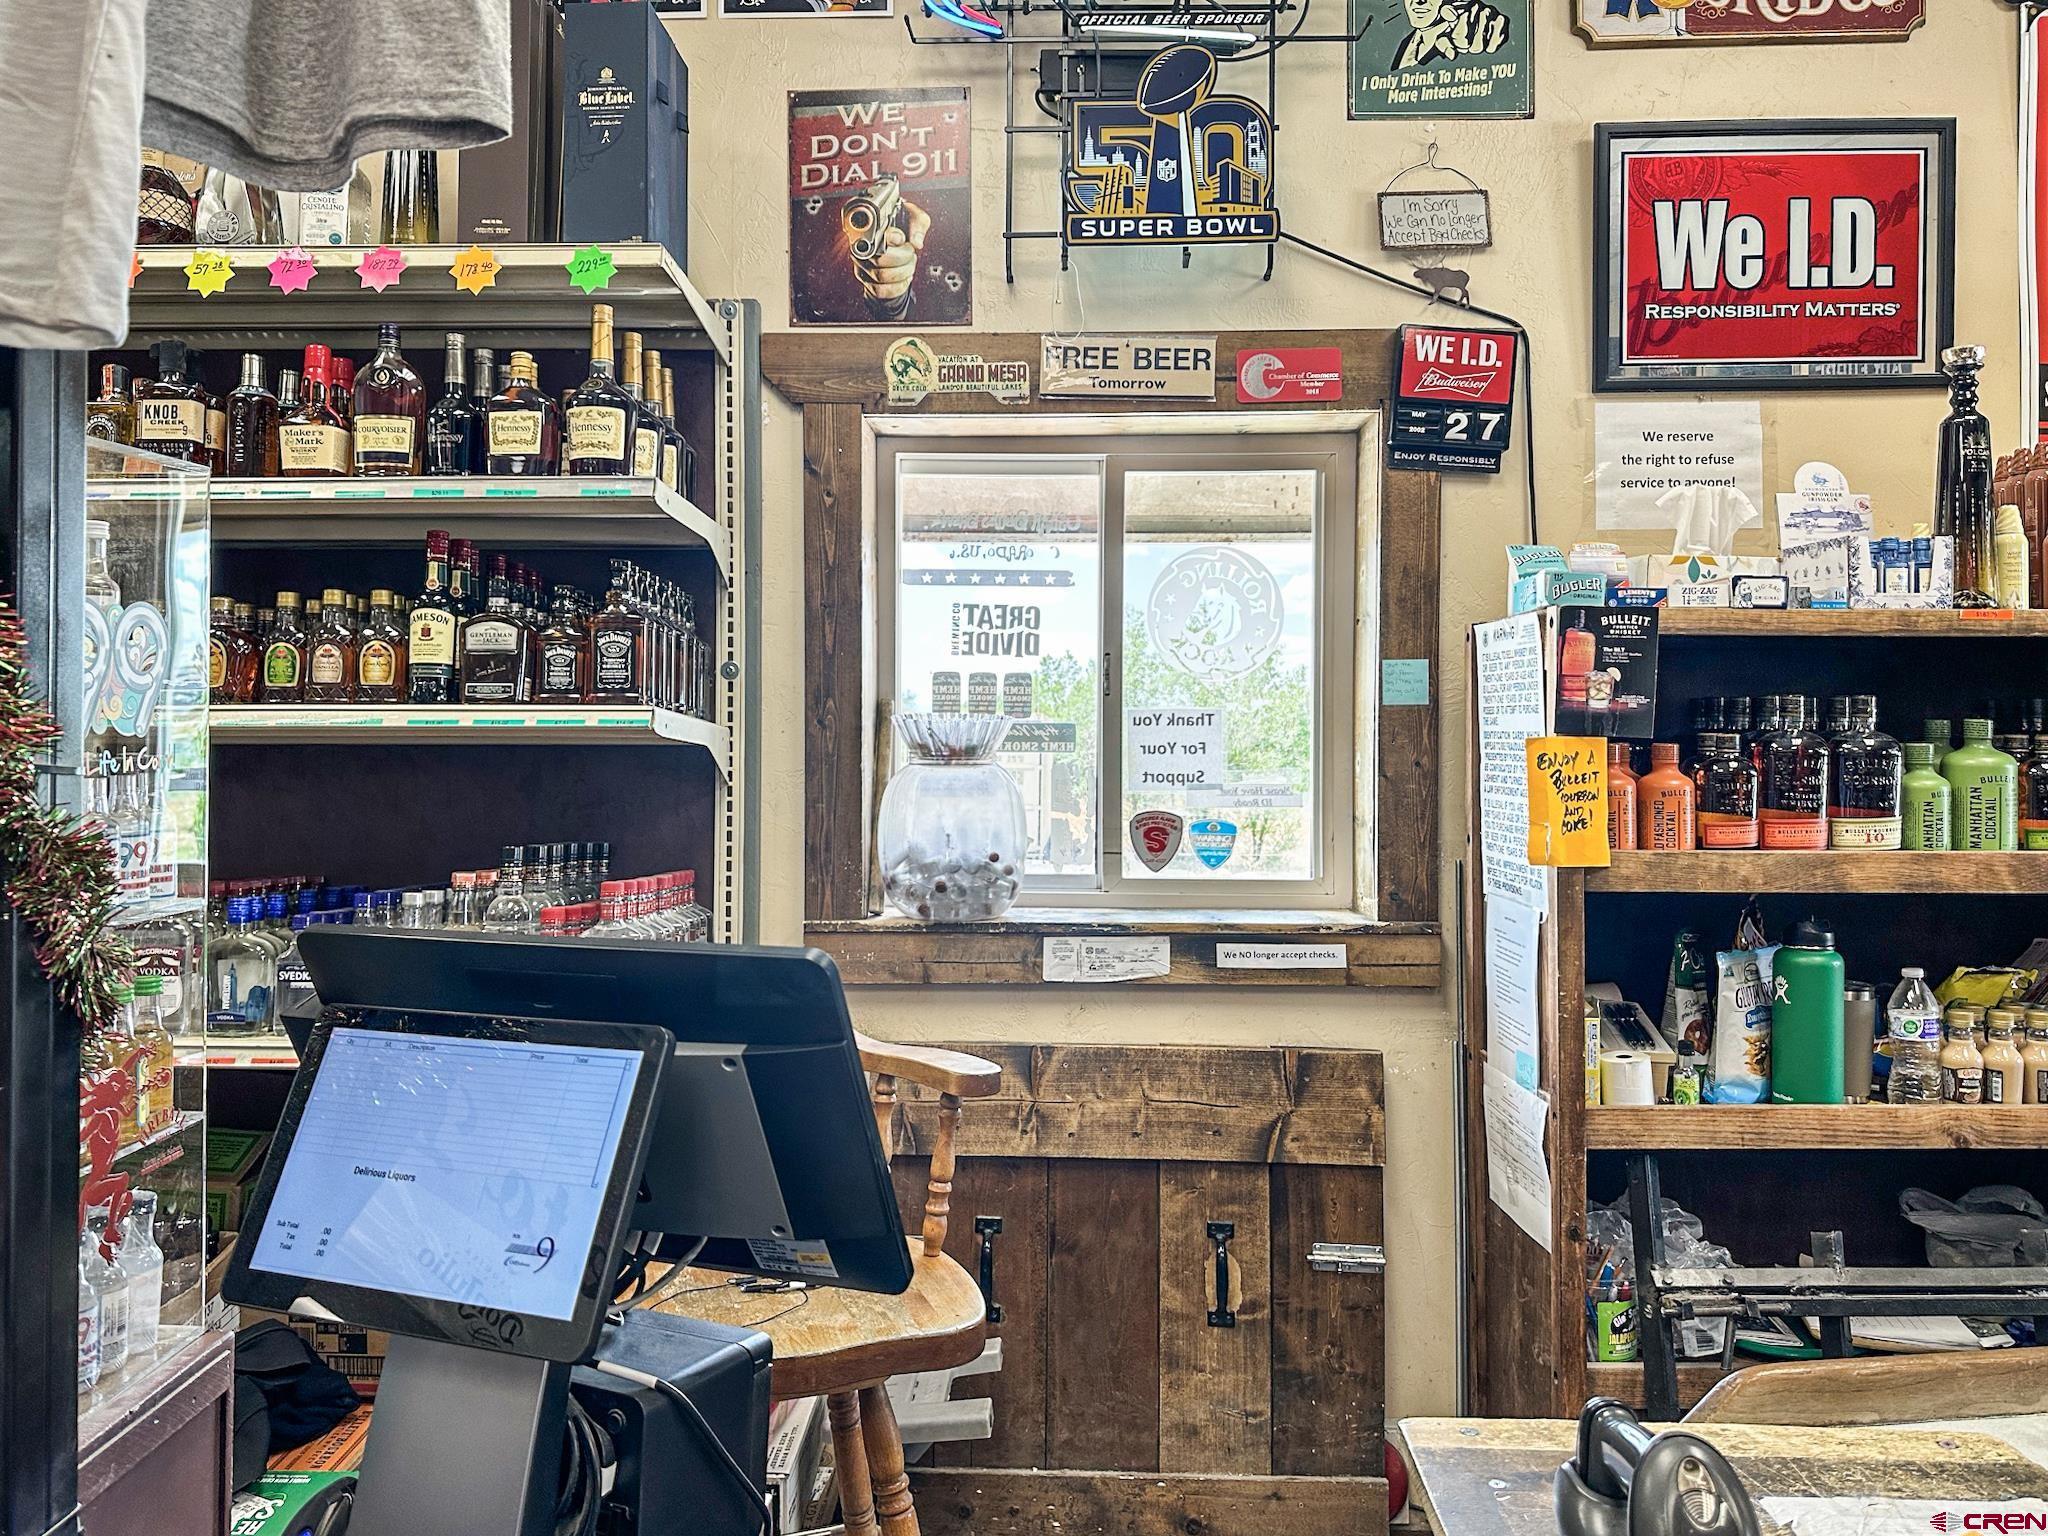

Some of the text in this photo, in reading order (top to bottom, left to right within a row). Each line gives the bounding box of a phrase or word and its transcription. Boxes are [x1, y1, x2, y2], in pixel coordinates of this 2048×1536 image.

[1079, 12, 1266, 26] OFFICIAL BEER SPONSOR
[1361, 63, 1517, 91] I Only Drink To Make YOU
[578, 91, 603, 106] Blue
[1387, 81, 1493, 104] More Interesting!
[837, 102, 906, 128] WE
[811, 126, 934, 161] DON'T
[801, 149, 959, 189] DIAL 911
[301, 202, 345, 212] CRISTALINO
[1402, 197, 1459, 215] I'm Sorry
[1081, 218, 1264, 237] SUPER BOWL
[1384, 212, 1484, 229] We Can Longer
[1388, 227, 1485, 244] Accept Bad Checks
[1653, 197, 1896, 290] We I.D.
[1644, 303, 1800, 321] RESPONSIBILITY
[1046, 346, 1211, 371] FREE BEER
[1415, 334, 1503, 368] WE I.D.
[938, 355, 979, 363] VACATION AT
[938, 363, 1027, 383] GRAND MESA
[1269, 371, 1340, 381] Chamber of Commerce
[1421, 368, 1488, 391] Budweiser
[1002, 383, 1023, 391] LAKES
[1088, 376, 1167, 391] Tomorrow
[1301, 380, 1325, 388] Member
[144, 404, 178, 420] KNOB
[285, 429, 324, 438] Maker's
[497, 423, 533, 434] Hennessy
[571, 422, 613, 434] Hennessy
[1444, 412, 1506, 441] 27
[427, 432, 464, 444] Hennessy
[1642, 431, 1714, 443] We reserve
[1394, 451, 1426, 461] ENJOY
[1429, 453, 1497, 466] RESPONSIBLY
[1622, 453, 1735, 467] the right to refuse
[1620, 477, 1665, 489] service
[1668, 477, 1681, 488] to
[1551, 577, 1603, 600] BUGLER
[1617, 590, 1657, 598] ELEMENTS
[1681, 587, 1718, 595] ZIG-ZAG
[1600, 615, 1652, 627] BULLEIT
[85, 750, 120, 777] Life
[1537, 750, 1596, 772] ENJOY A
[1654, 800, 1665, 842] FASHIONED
[1969, 786, 1983, 849] MANHATTAN
[1985, 797, 1998, 840] COCKTAIL
[1666, 809, 1676, 849] COCKTAIL
[1223, 950, 1339, 961] We NO longer accept checks.
[139, 966, 176, 976] VODKA
[278, 971, 313, 982] SVEDK
[530, 1053, 545, 1061] Price
[574, 1056, 589, 1064] Total
[353, 1165, 416, 1183] Delirious Liquors
[287, 1220, 300, 1229] Total
[286, 1232, 296, 1240] Tax
[280, 1242, 293, 1251] Total
